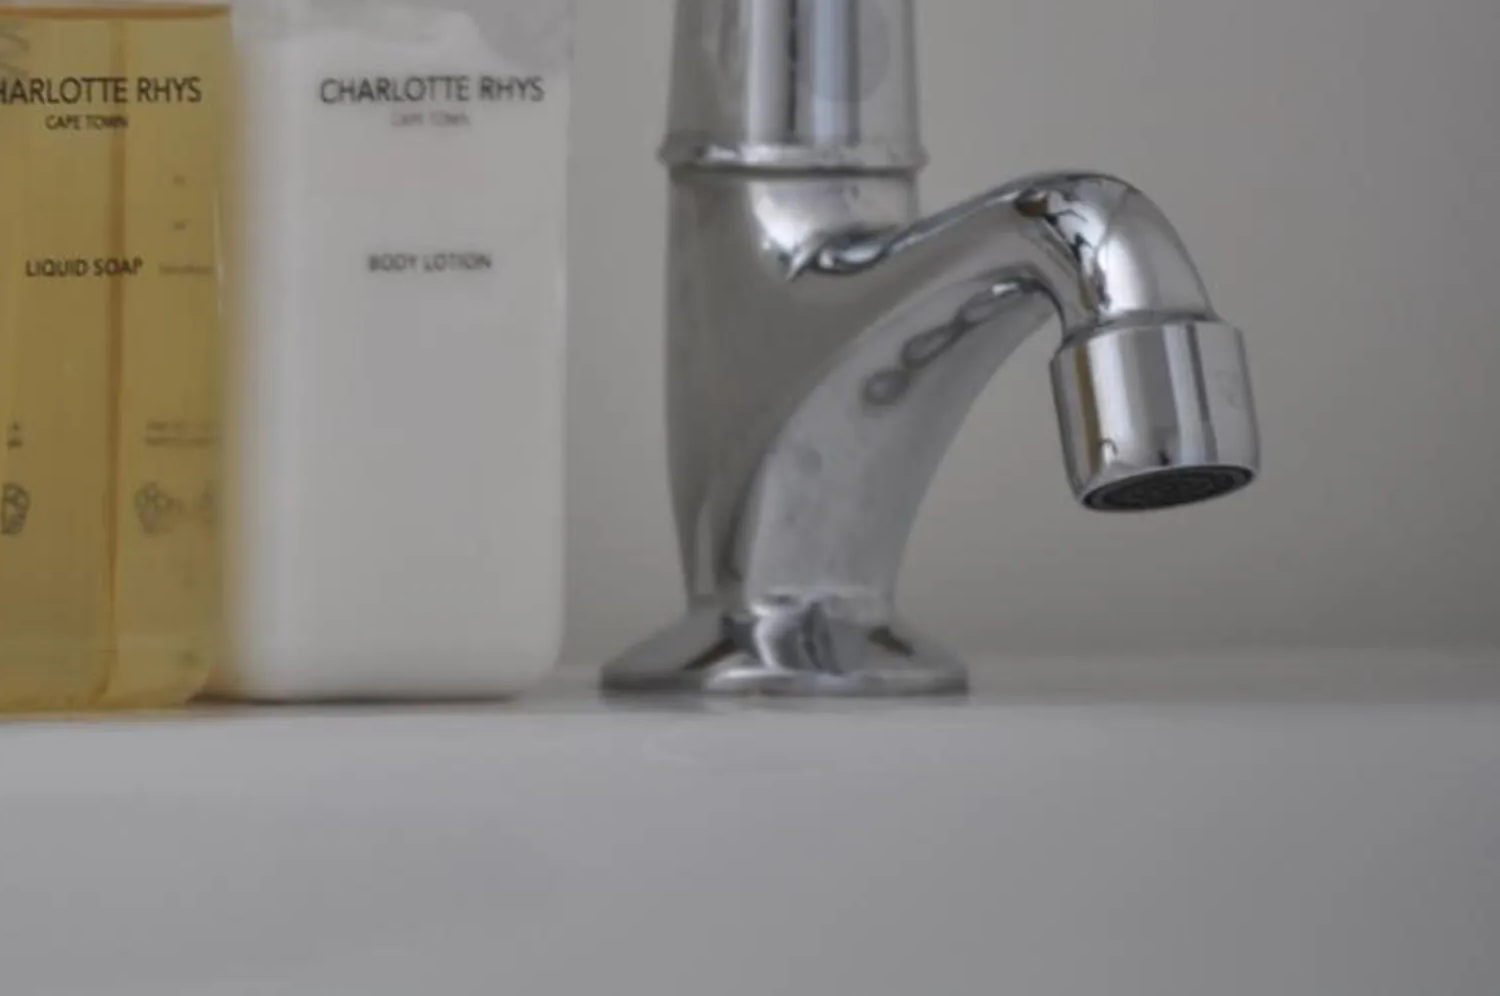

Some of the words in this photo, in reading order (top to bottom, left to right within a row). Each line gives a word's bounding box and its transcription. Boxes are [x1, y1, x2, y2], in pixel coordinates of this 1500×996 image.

[137, 76, 202, 103] RHYS
[320, 76, 470, 103] CHARLOTTE
[480, 75, 544, 102] RHYS
[45, 114, 82, 130] CAPE
[85, 114, 129, 130] TOWN
[25, 258, 88, 278] LIQUID
[93, 257, 143, 277] SOAP
[368, 253, 417, 273] BODY
[423, 252, 492, 272] LOTION
